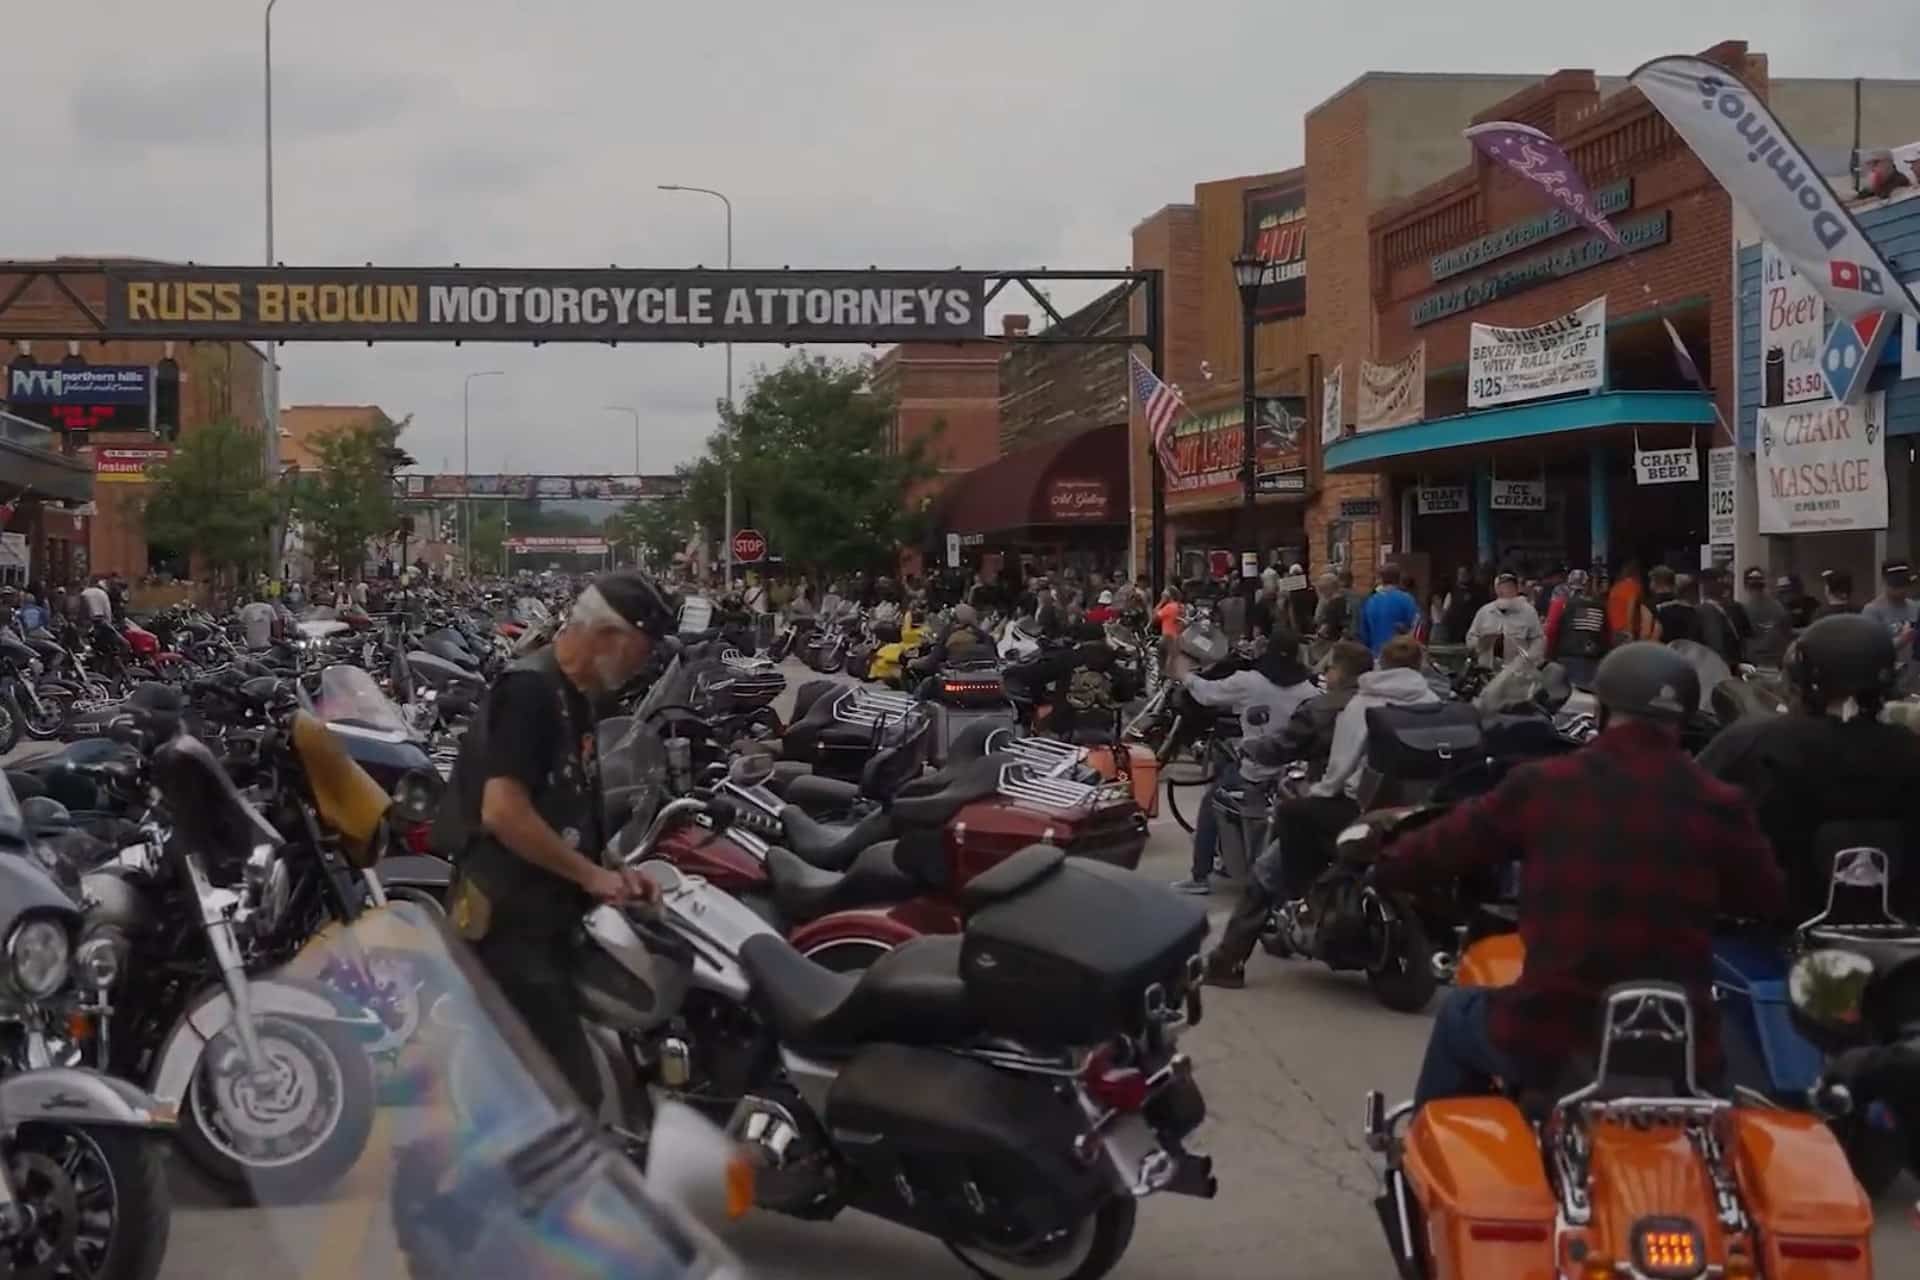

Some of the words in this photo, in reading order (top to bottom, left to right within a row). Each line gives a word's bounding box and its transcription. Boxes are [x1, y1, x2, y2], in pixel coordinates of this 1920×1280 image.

[1698, 76, 1847, 250] Domino's
[128, 282, 241, 321] RUSS
[257, 284, 418, 323] BROWN
[429, 285, 713, 325] MOTORCYCLE
[724, 287, 971, 325] ATTORNEYS
[1769, 287, 1816, 331] Beer
[1482, 358, 1516, 372] WITH
[1562, 342, 1587, 360] CUP
[63, 371, 115, 382] northern
[118, 371, 144, 382] hills
[1787, 373, 1822, 397] $3.50
[1473, 377, 1502, 398] $125
[1784, 408, 1850, 446] CHAIR
[98, 462, 138, 473] Instant
[1640, 453, 1692, 467] CRAFT
[1648, 466, 1688, 479] BEER
[1769, 459, 1870, 498] MASSAGE
[1422, 489, 1464, 500] CRAFT
[1507, 485, 1529, 494] ICE
[1495, 495, 1543, 506] CREAM
[736, 540, 763, 553] STOP
